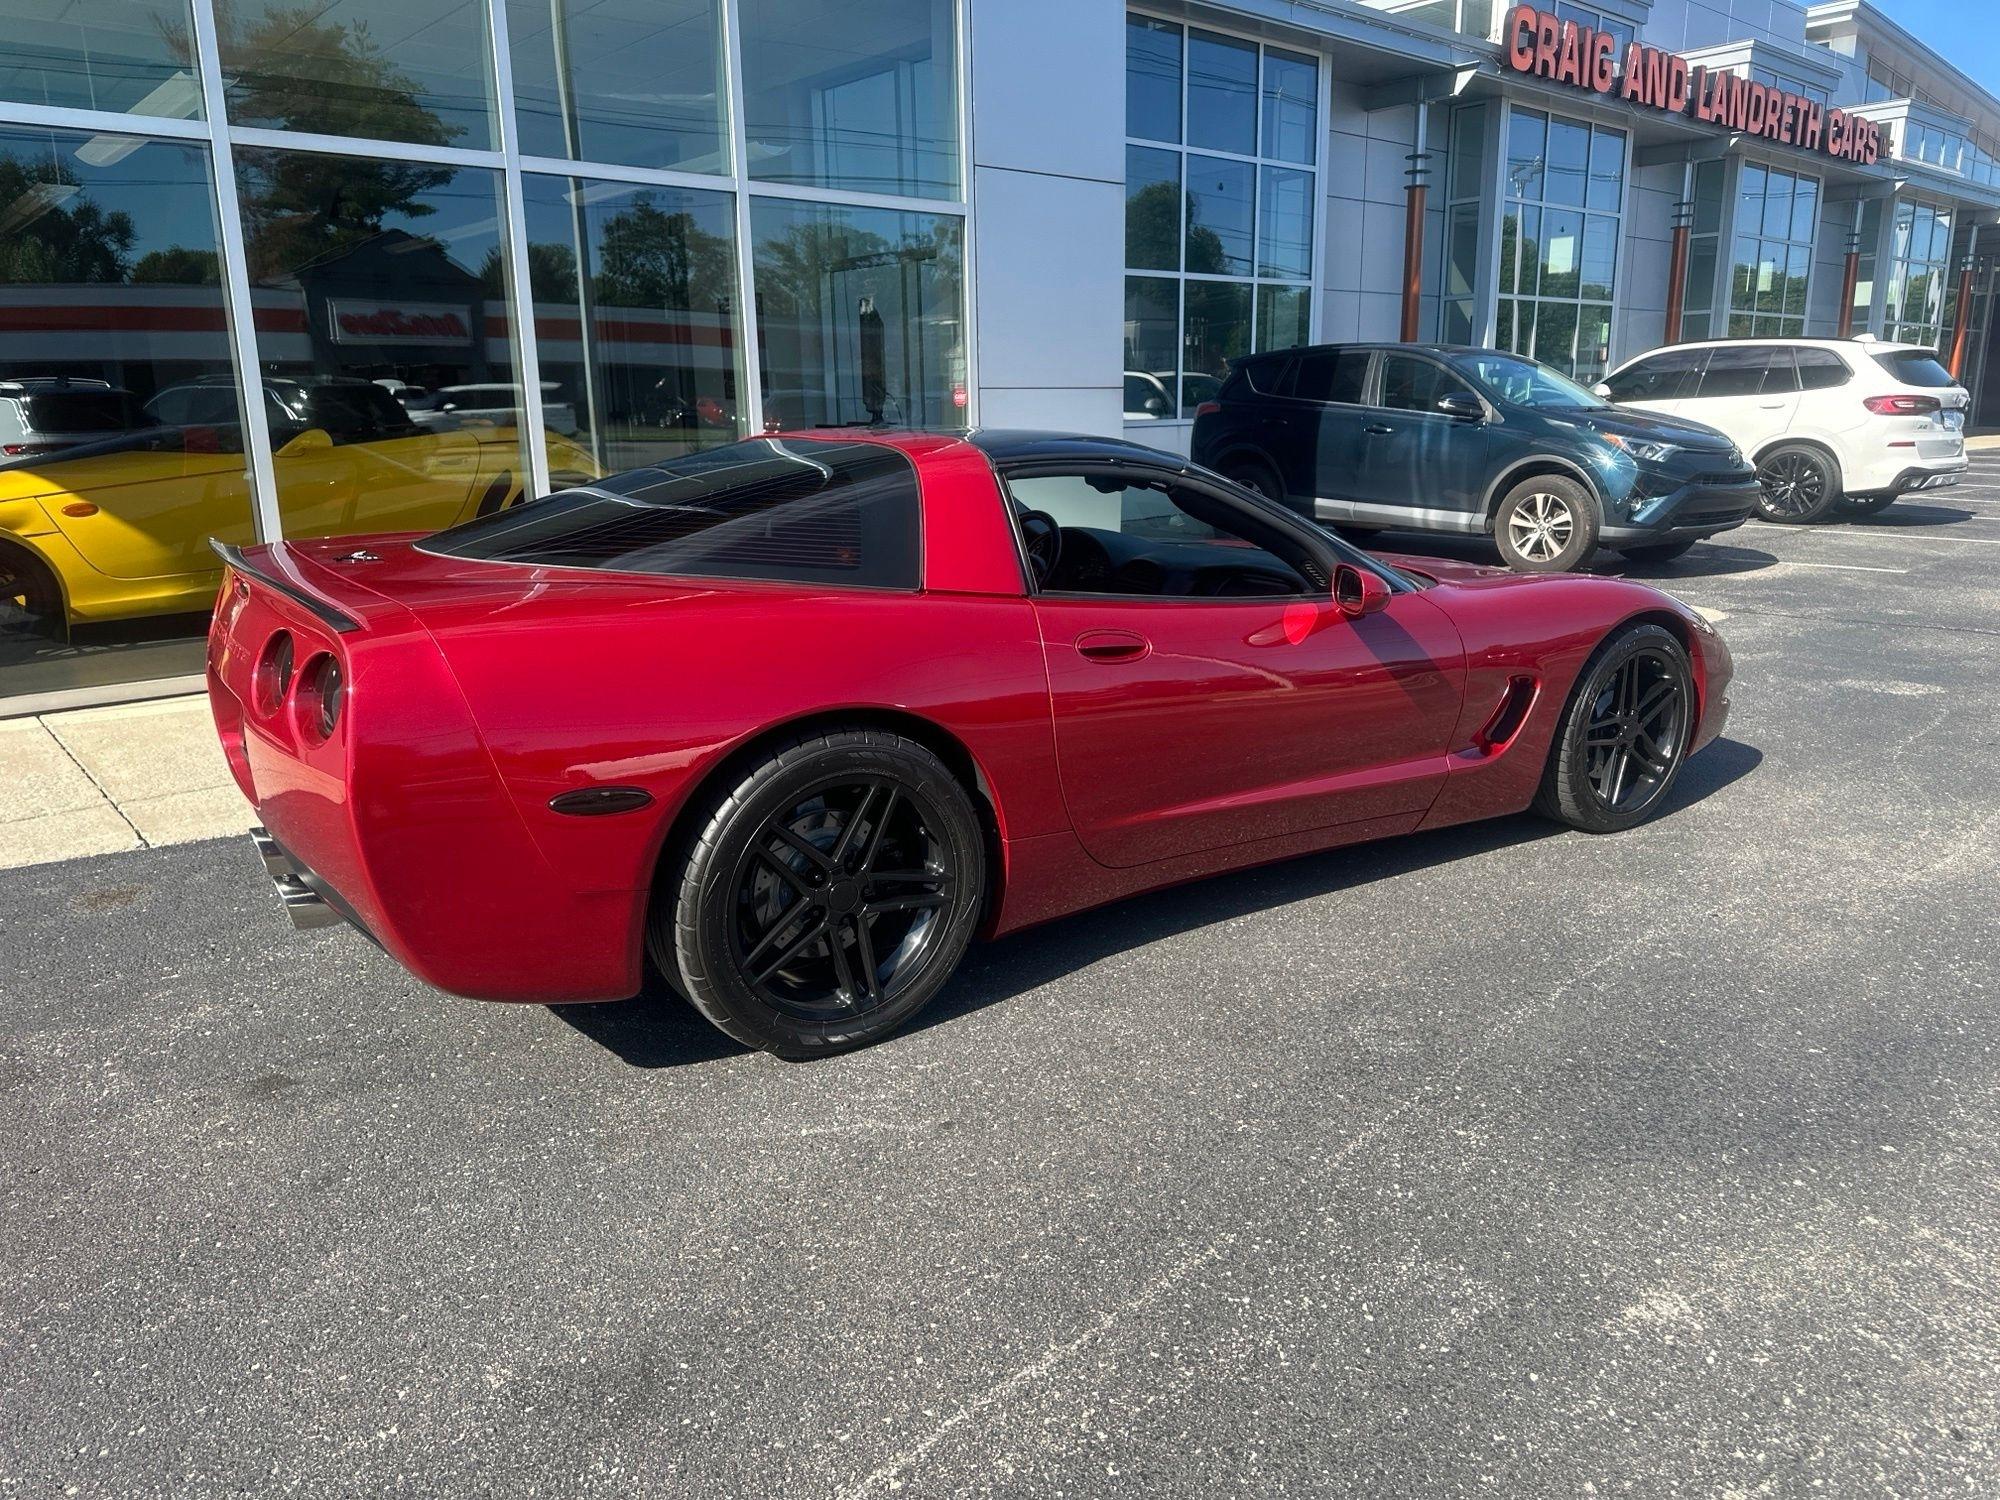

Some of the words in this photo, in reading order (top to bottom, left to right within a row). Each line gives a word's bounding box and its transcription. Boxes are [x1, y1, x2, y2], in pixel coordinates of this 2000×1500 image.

[1510, 4, 1614, 93] CRAIG
[1621, 41, 1688, 112] AND
[1697, 64, 1824, 150] LANDRETH
[1828, 107, 1880, 166] CARS
